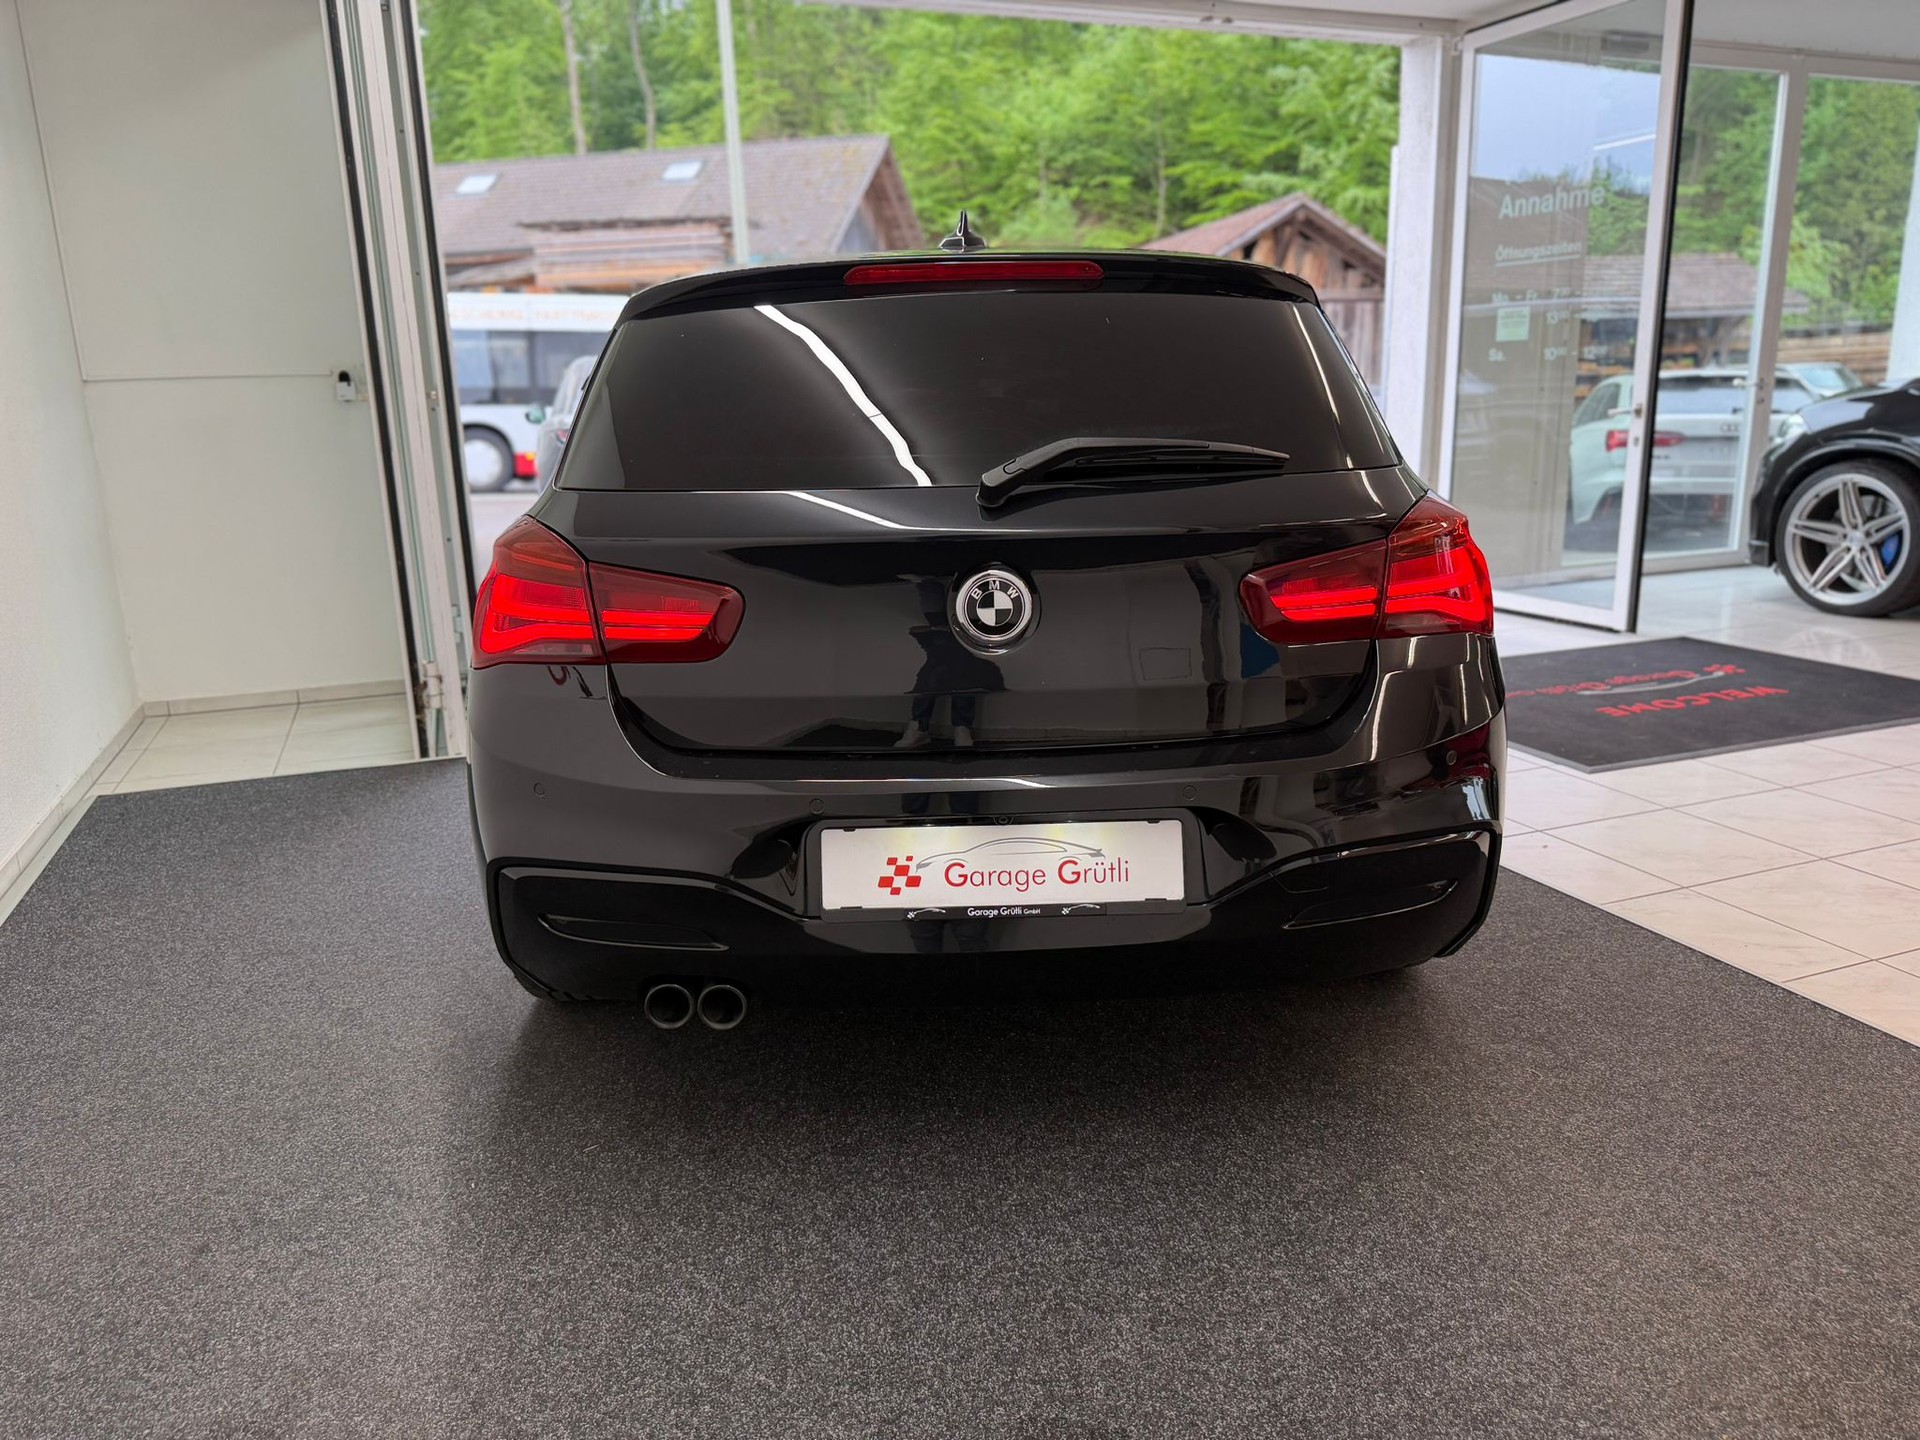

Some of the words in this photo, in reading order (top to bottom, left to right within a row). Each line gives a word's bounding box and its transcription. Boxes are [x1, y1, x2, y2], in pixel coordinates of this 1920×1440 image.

[1499, 185, 1606, 219] Annahme
[971, 580, 1019, 600] BMW
[1595, 686, 1789, 717] WELCOME
[944, 862, 1046, 892] Garage
[1058, 857, 1129, 884] Grütli
[967, 907, 998, 918] Garage
[1000, 906, 1022, 915] Grütli
